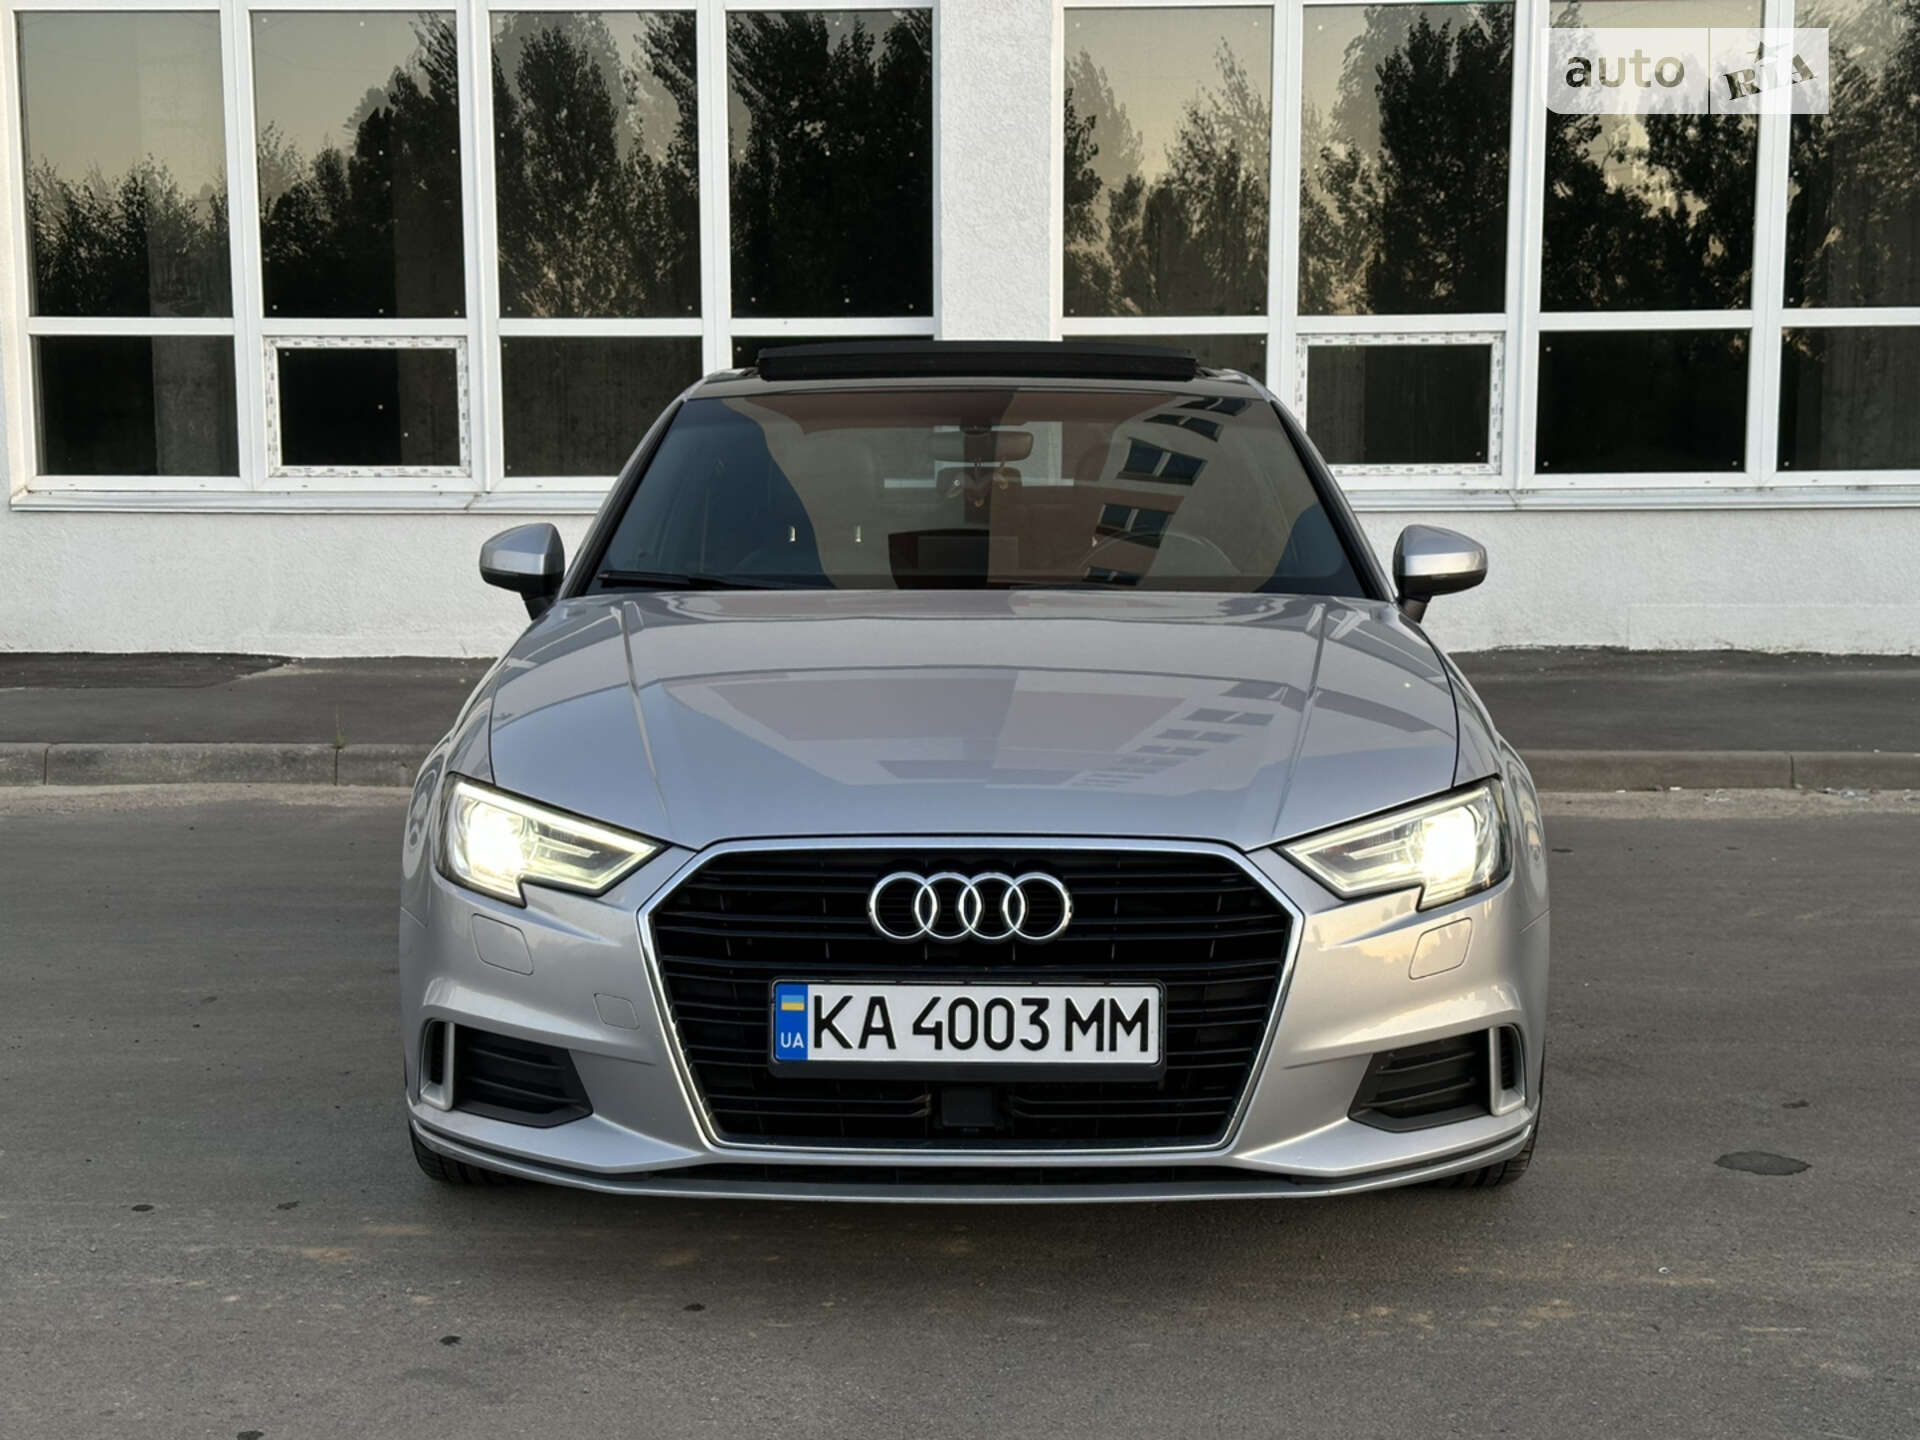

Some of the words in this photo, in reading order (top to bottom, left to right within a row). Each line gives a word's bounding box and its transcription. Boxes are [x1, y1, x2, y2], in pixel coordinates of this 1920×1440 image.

[780, 1032, 805, 1049] UA
[813, 994, 897, 1049] KA
[911, 996, 1050, 1051] 4003
[1064, 997, 1149, 1052] MM
